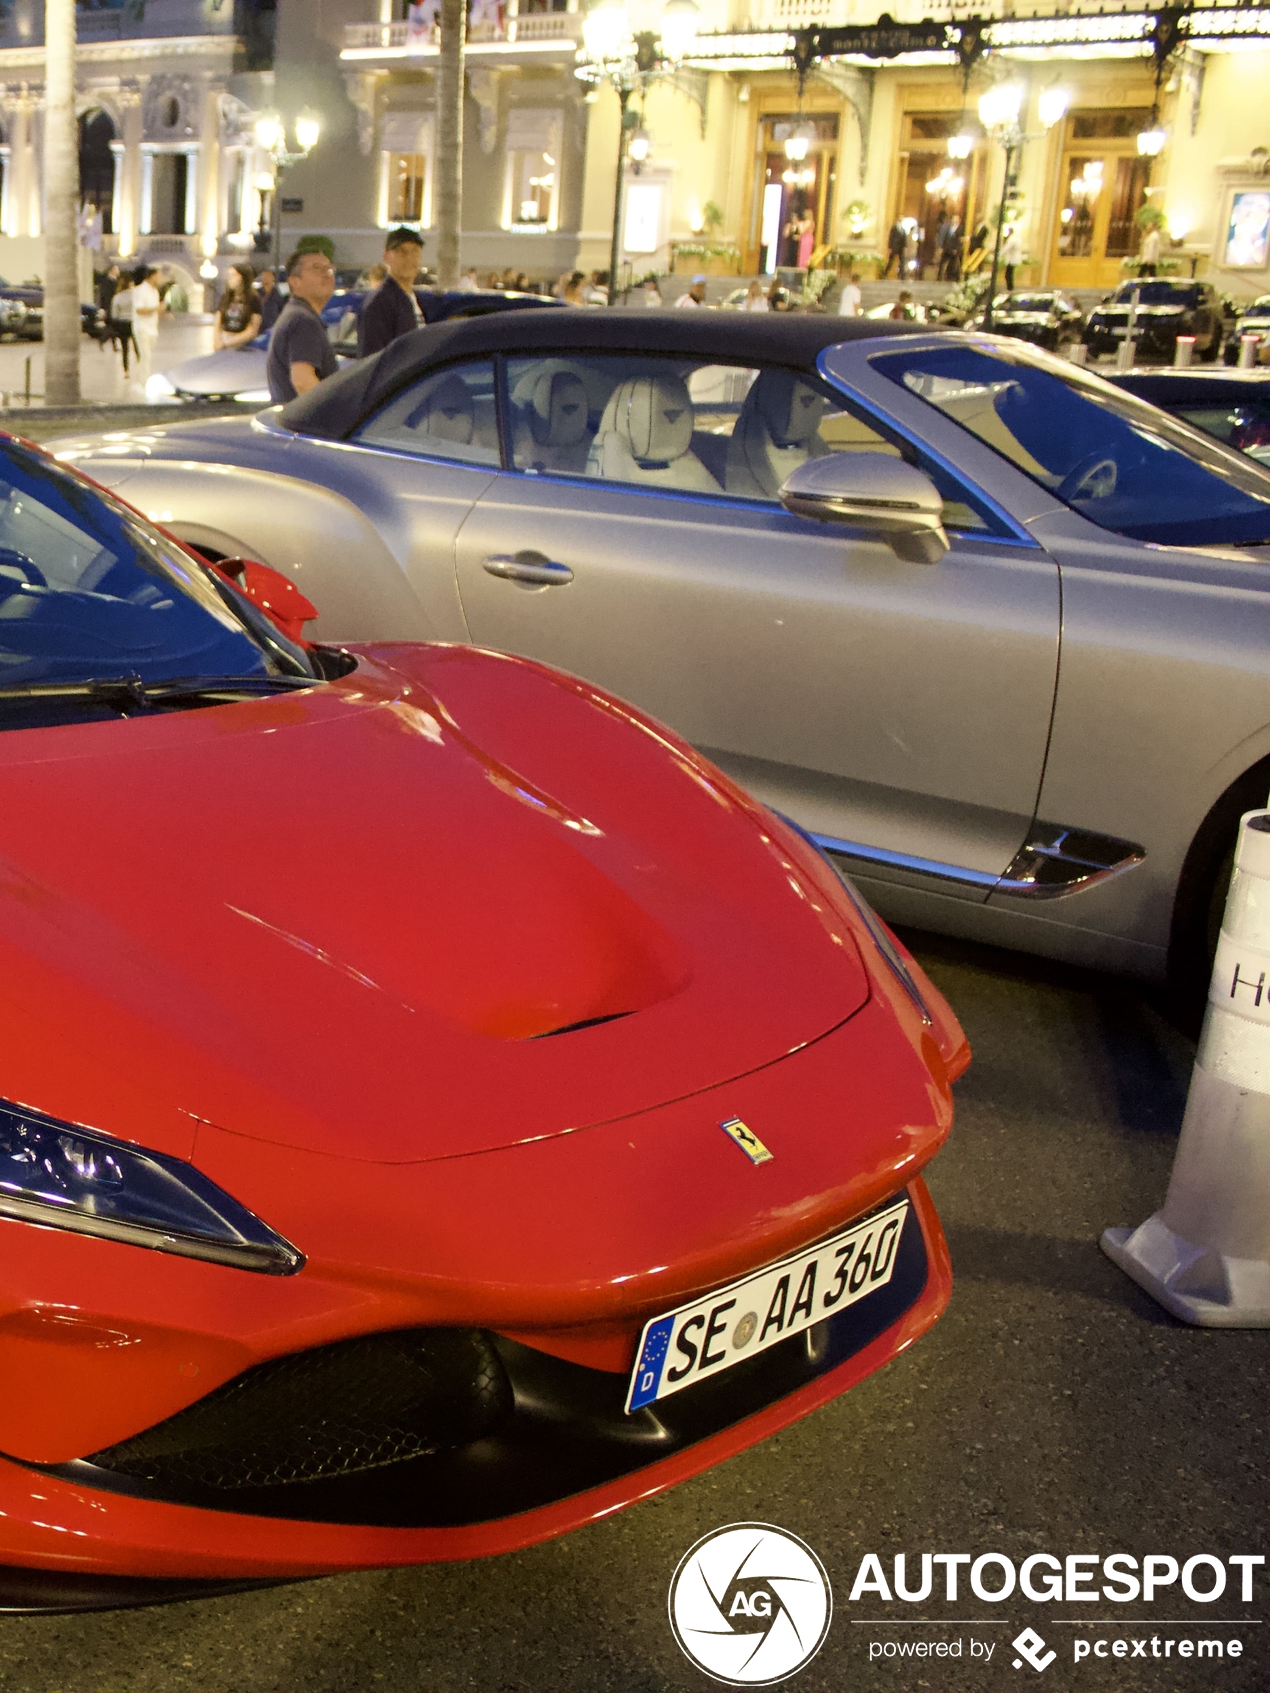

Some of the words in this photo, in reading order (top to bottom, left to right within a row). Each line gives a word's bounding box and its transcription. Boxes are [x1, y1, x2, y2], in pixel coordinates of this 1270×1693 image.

[1230, 963, 1270, 1007] H
[667, 1298, 736, 1382] SE
[759, 1259, 818, 1342] AA
[823, 1218, 899, 1308] 360
[641, 1372, 654, 1392] D
